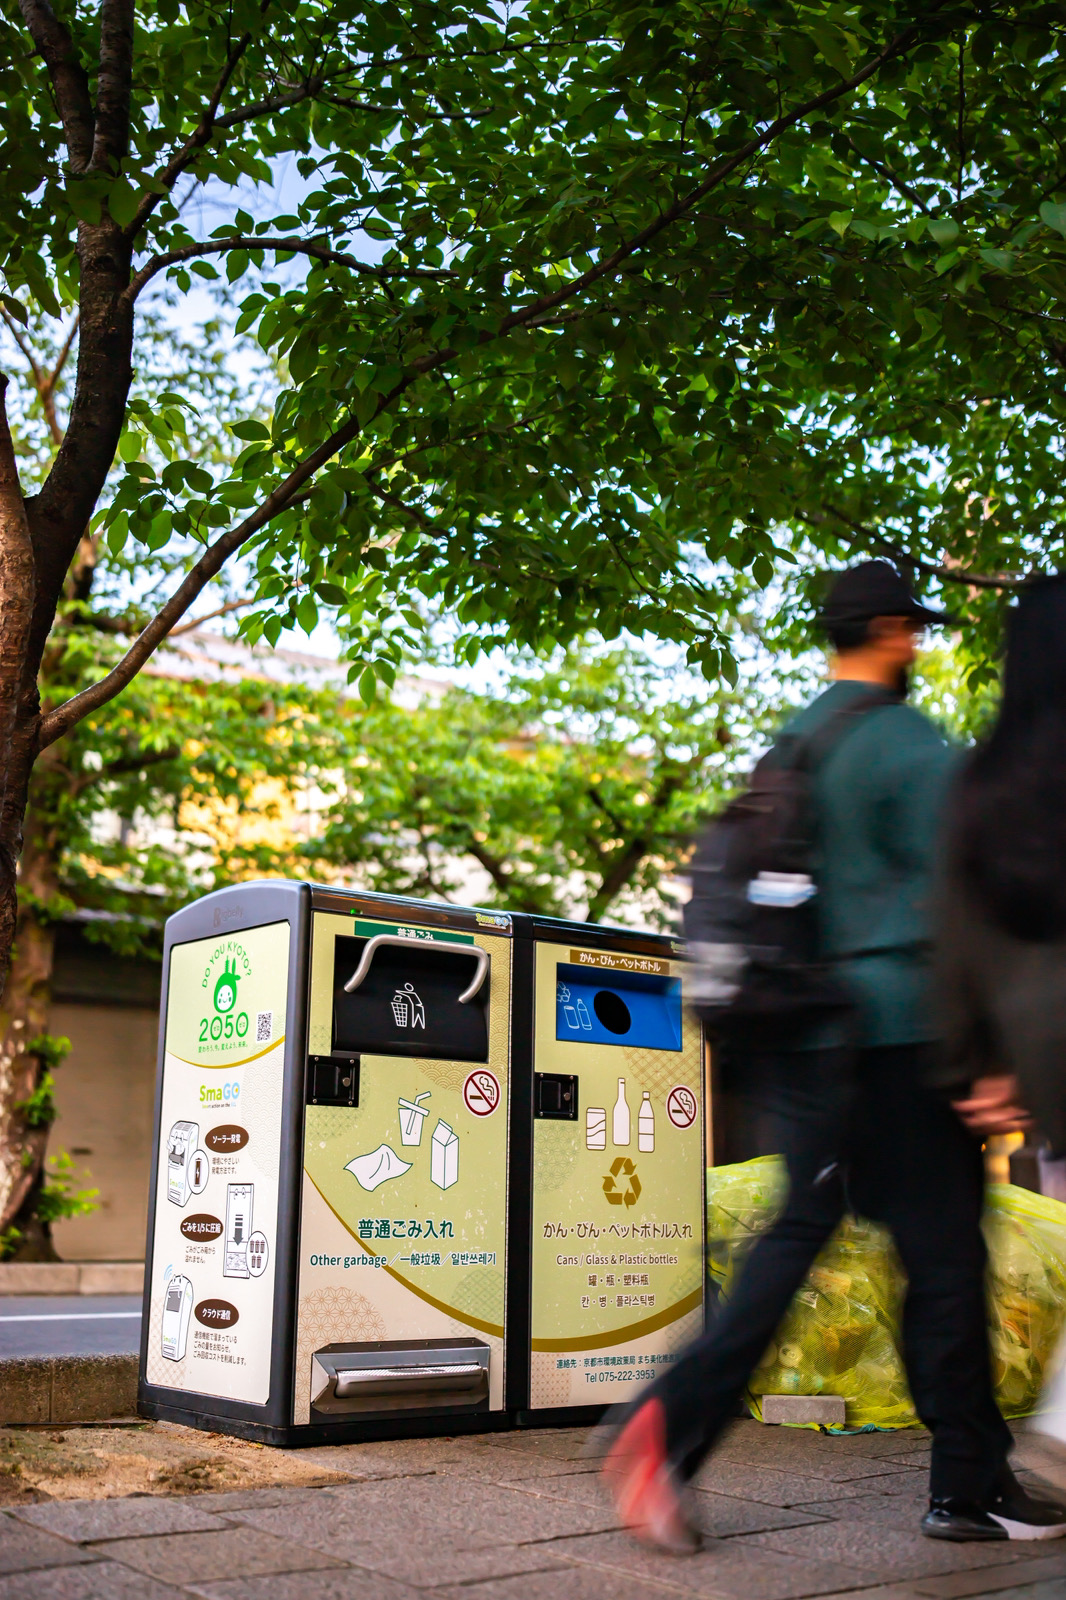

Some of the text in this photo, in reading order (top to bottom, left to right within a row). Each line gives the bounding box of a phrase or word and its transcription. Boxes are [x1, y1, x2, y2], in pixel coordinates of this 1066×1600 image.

[202, 941, 252, 988] DO YOU KYOTO?
[579, 952, 662, 972] かん・びん・ペットボトル
[198, 1011, 249, 1042] 2050
[199, 1082, 241, 1102] SmaGO
[212, 1133, 241, 1144] ソーラー発電
[358, 1218, 455, 1239] 普通ごみ入れ
[543, 1222, 693, 1239] かん・びん・ペットボトル入れ
[310, 1254, 341, 1266] Other
[343, 1254, 387, 1268] garbage
[556, 1254, 579, 1266] Cans
[586, 1254, 609, 1266] Glass
[610, 1254, 617, 1265] &
[619, 1253, 647, 1265] Plastic
[649, 1253, 678, 1265] bottles
[202, 1308, 231, 1321] クラウド通信
[585, 1369, 656, 1383] Tel 075-222-3953
